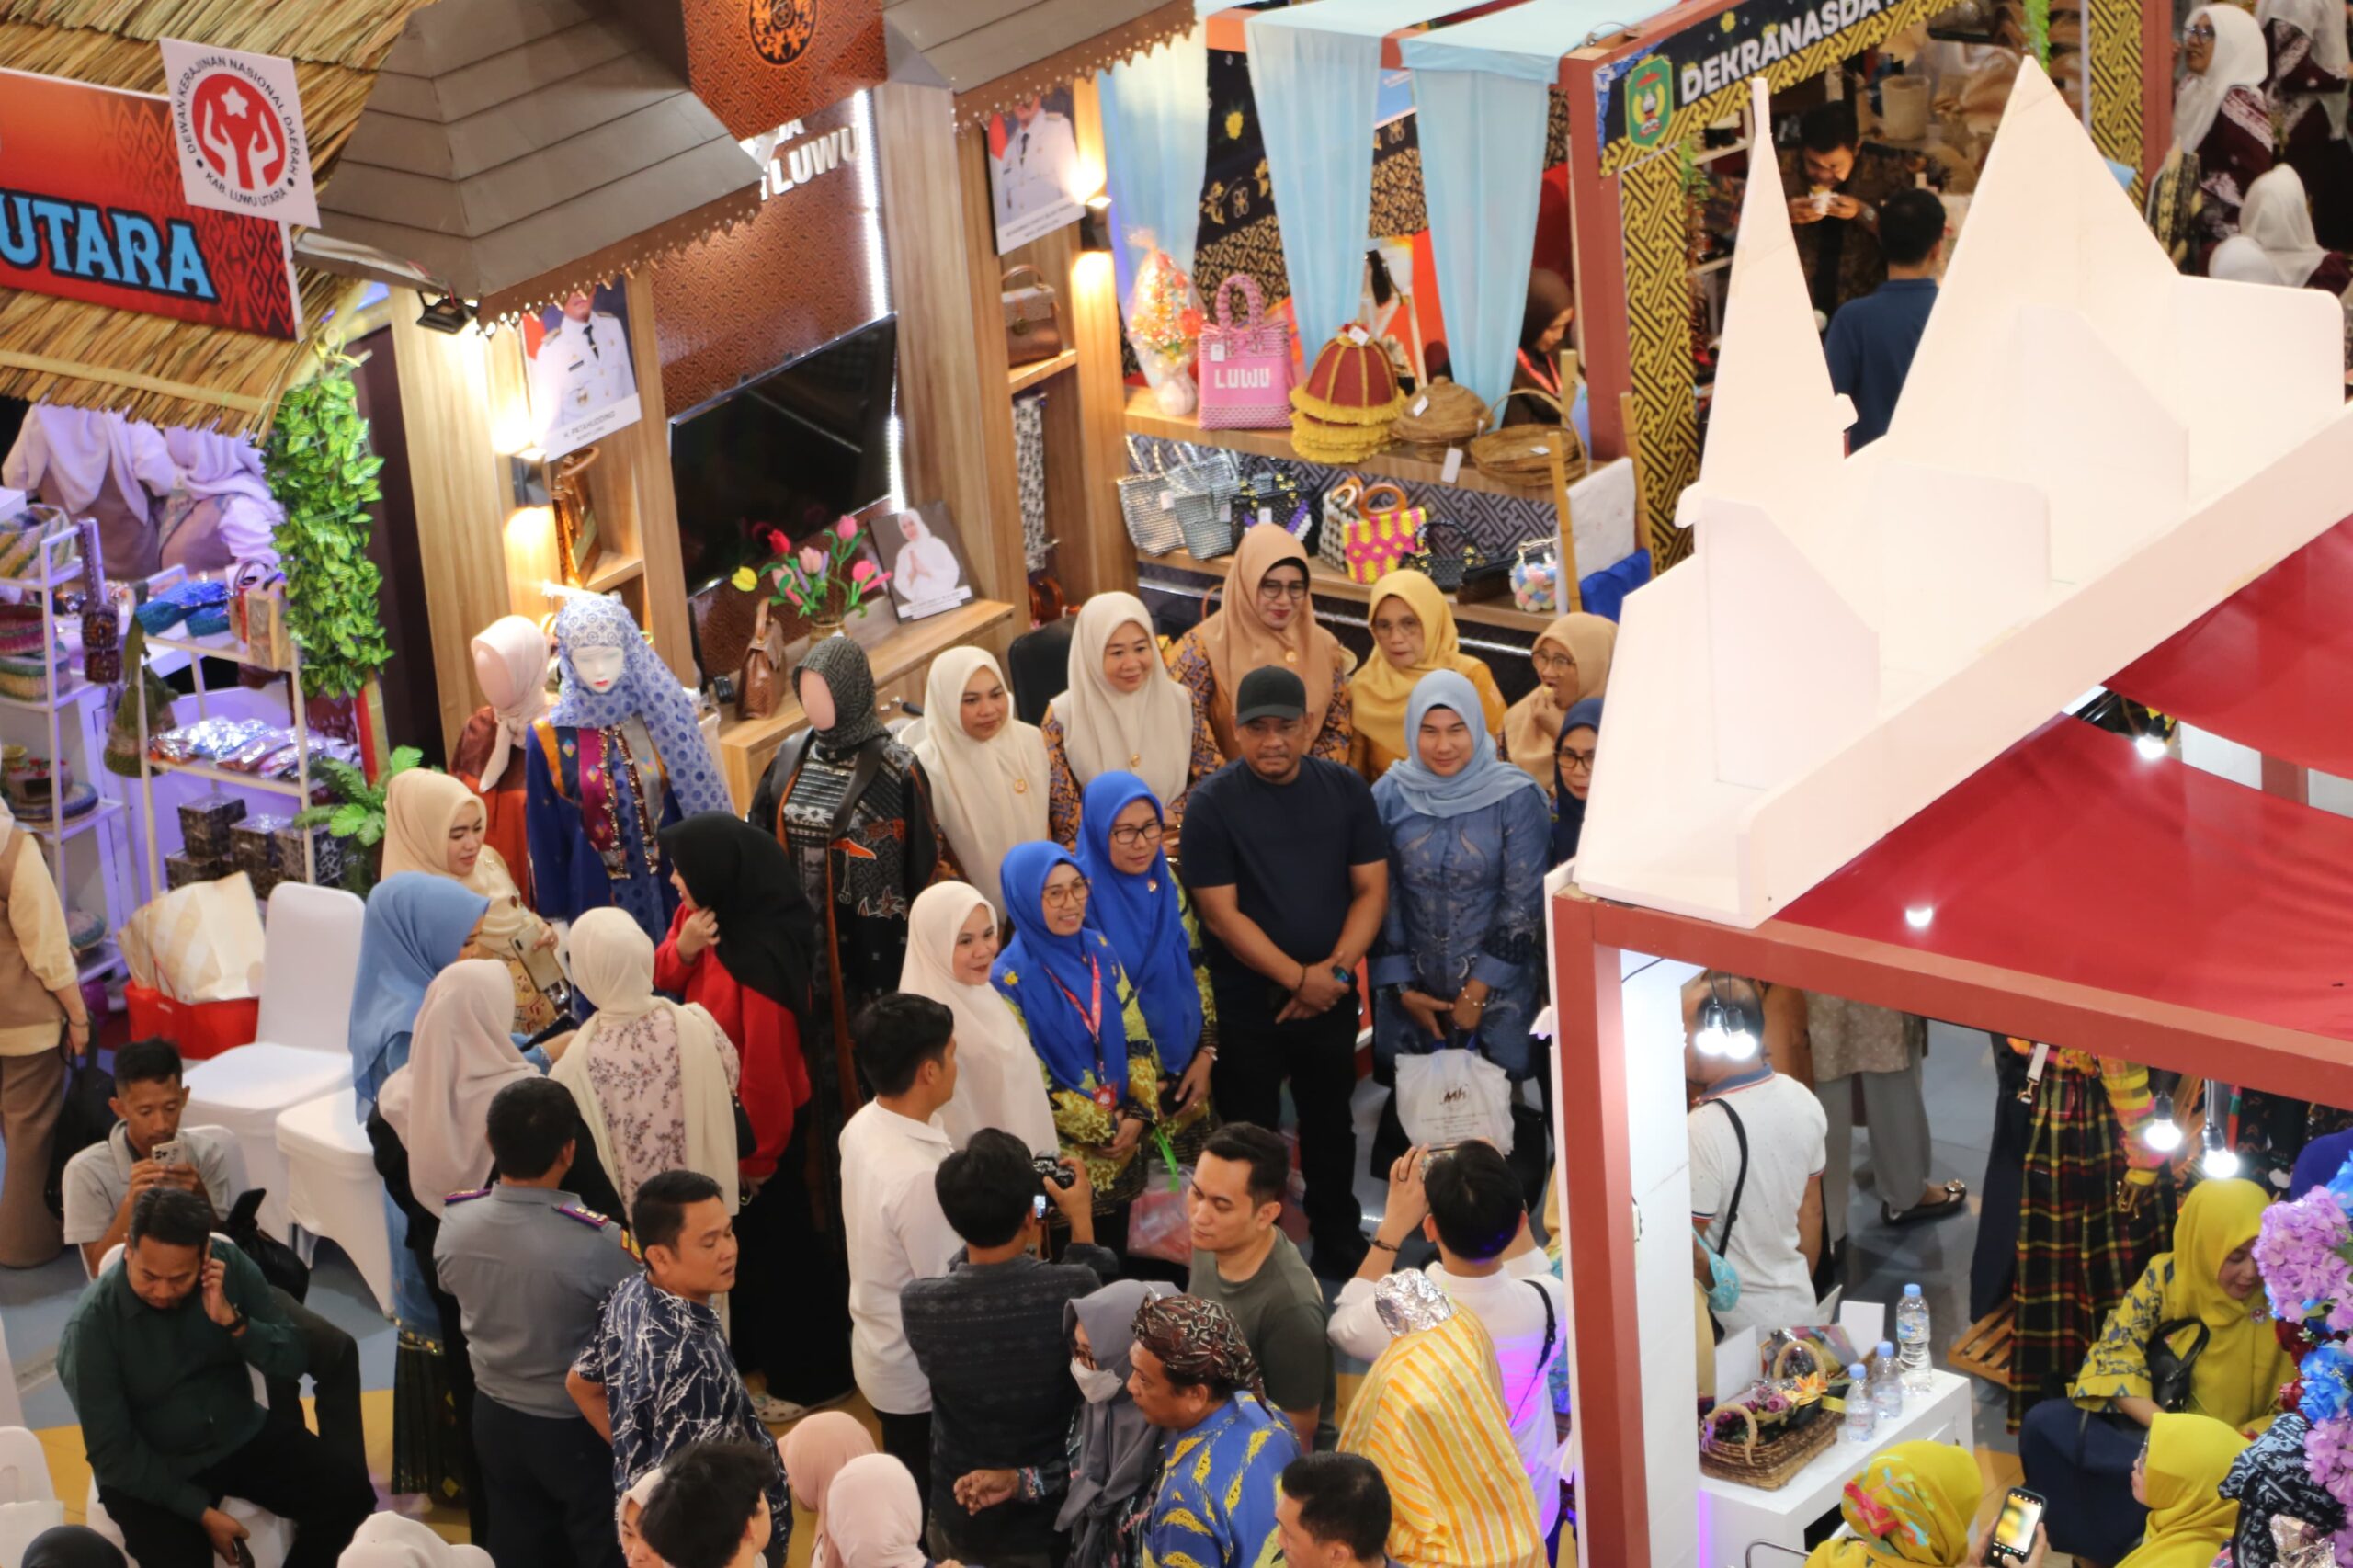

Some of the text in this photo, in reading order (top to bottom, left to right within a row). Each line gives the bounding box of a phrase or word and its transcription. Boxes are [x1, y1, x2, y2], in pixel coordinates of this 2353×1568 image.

[176, 55, 300, 176] DEWAN KERAJINAN NASIONAL DAERAH
[205, 172, 288, 207] KAB. LUWU UTARA
[769, 126, 861, 195] LUWU
[0, 192, 218, 301] UTARA
[1214, 368, 1270, 389] LUWU
